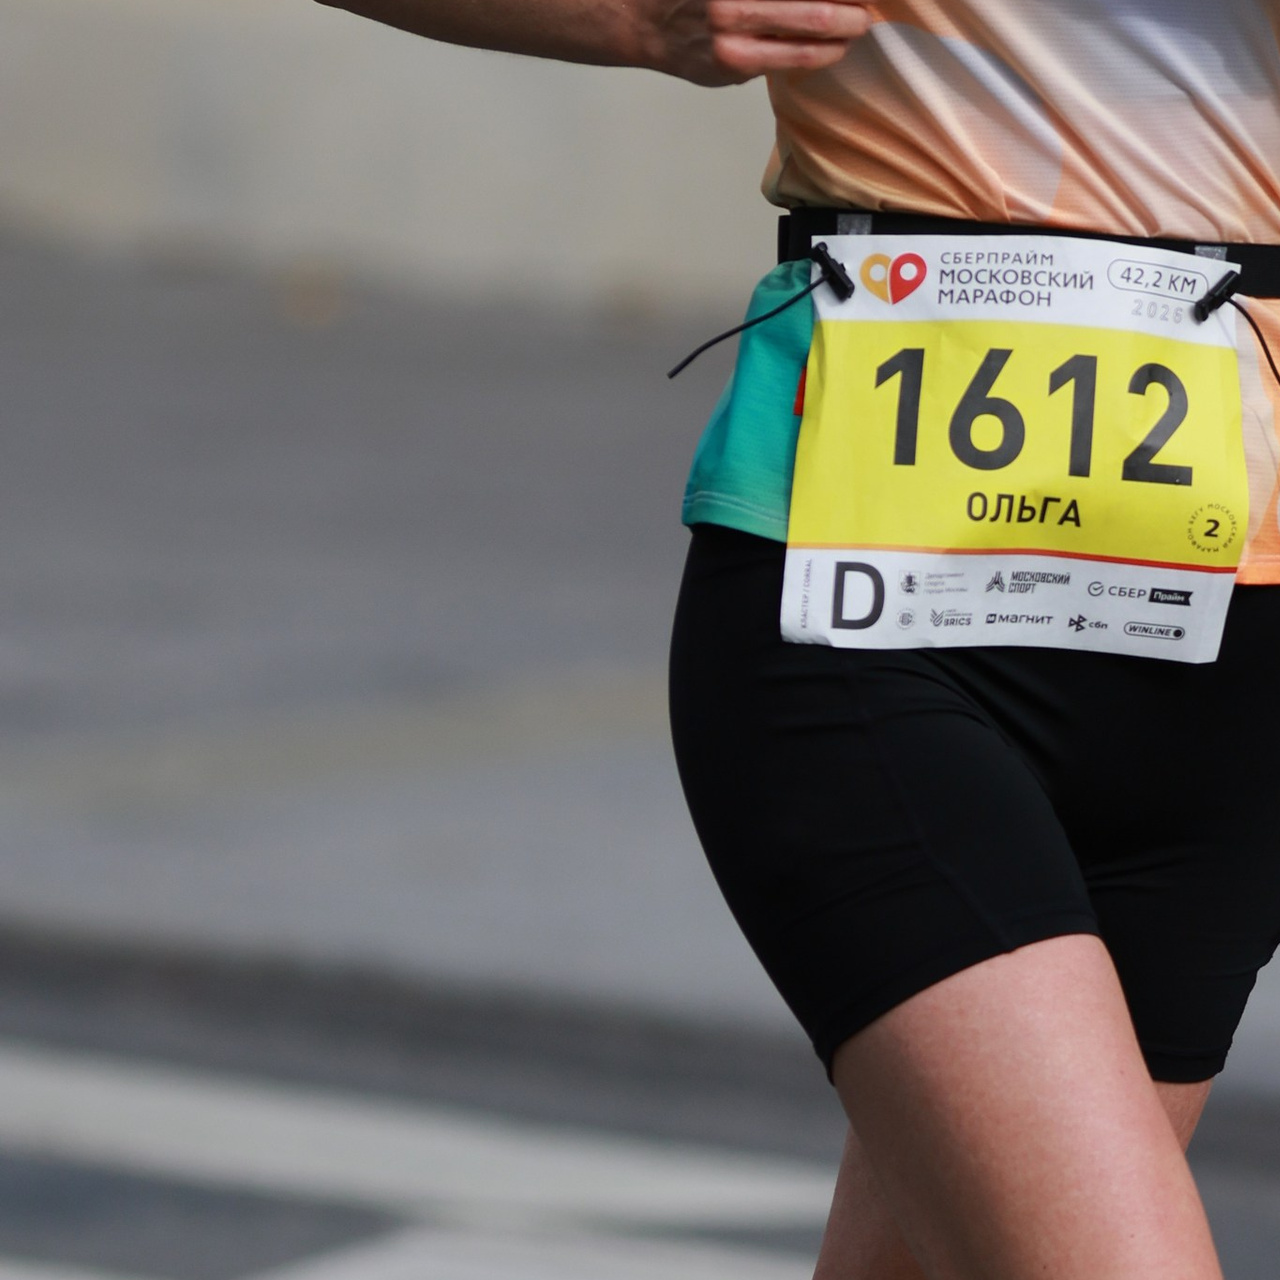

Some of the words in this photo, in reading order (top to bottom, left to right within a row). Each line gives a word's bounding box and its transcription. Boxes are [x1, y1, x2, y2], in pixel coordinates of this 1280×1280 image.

[940, 250, 1054, 266] СБЕРПРАЙМ
[939, 268, 1094, 290] МОСКОВСКИЙ
[1120, 266, 1162, 289] 42,2
[937, 288, 1052, 307] МАРАФОН
[874, 347, 1194, 487] 1612
[966, 491, 1082, 528] ОЛЬГА
[1203, 518, 1220, 538] 2
[1011, 571, 1071, 585] МОСКОВСКИЙ
[831, 561, 885, 630] D
[1008, 582, 1036, 594] СПОРТ
[1108, 585, 1147, 599] СБЕР
[1128, 624, 1172, 637] WINLINE
